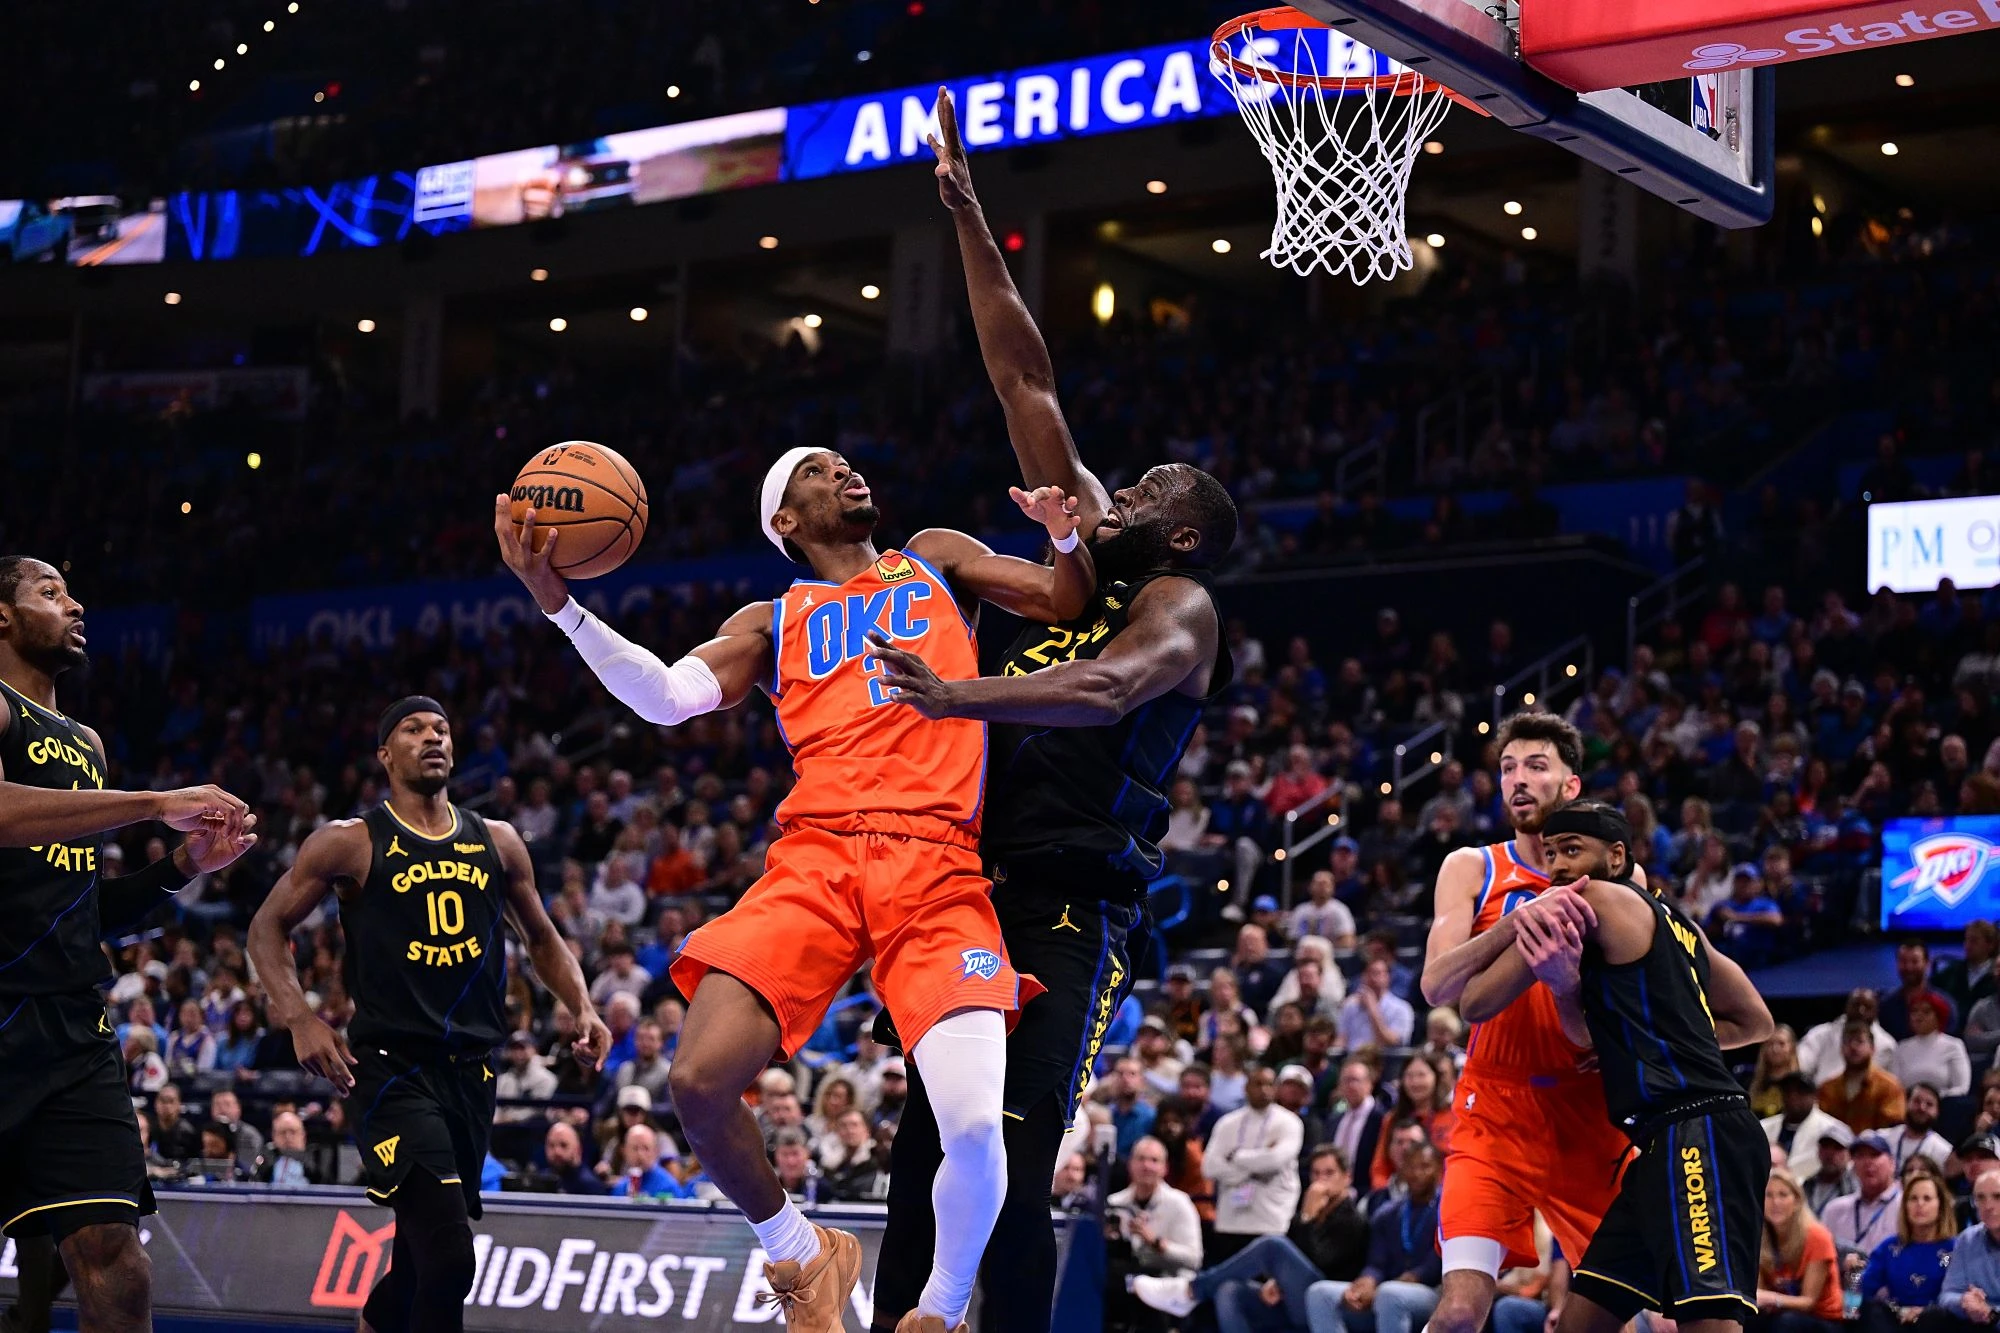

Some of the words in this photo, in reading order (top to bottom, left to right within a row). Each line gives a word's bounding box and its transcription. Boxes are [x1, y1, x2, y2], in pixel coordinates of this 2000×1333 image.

[1784, 9, 1978, 53] State
[511, 484, 585, 513] Wilson
[806, 580, 932, 680] OKC
[27, 736, 104, 791] GOLDEN
[29, 842, 96, 872] TATE
[391, 860, 490, 893] GOLDEN
[426, 890, 465, 936] 10
[406, 936, 482, 967] STATE
[1681, 1146, 1717, 1273] WARRIORS
